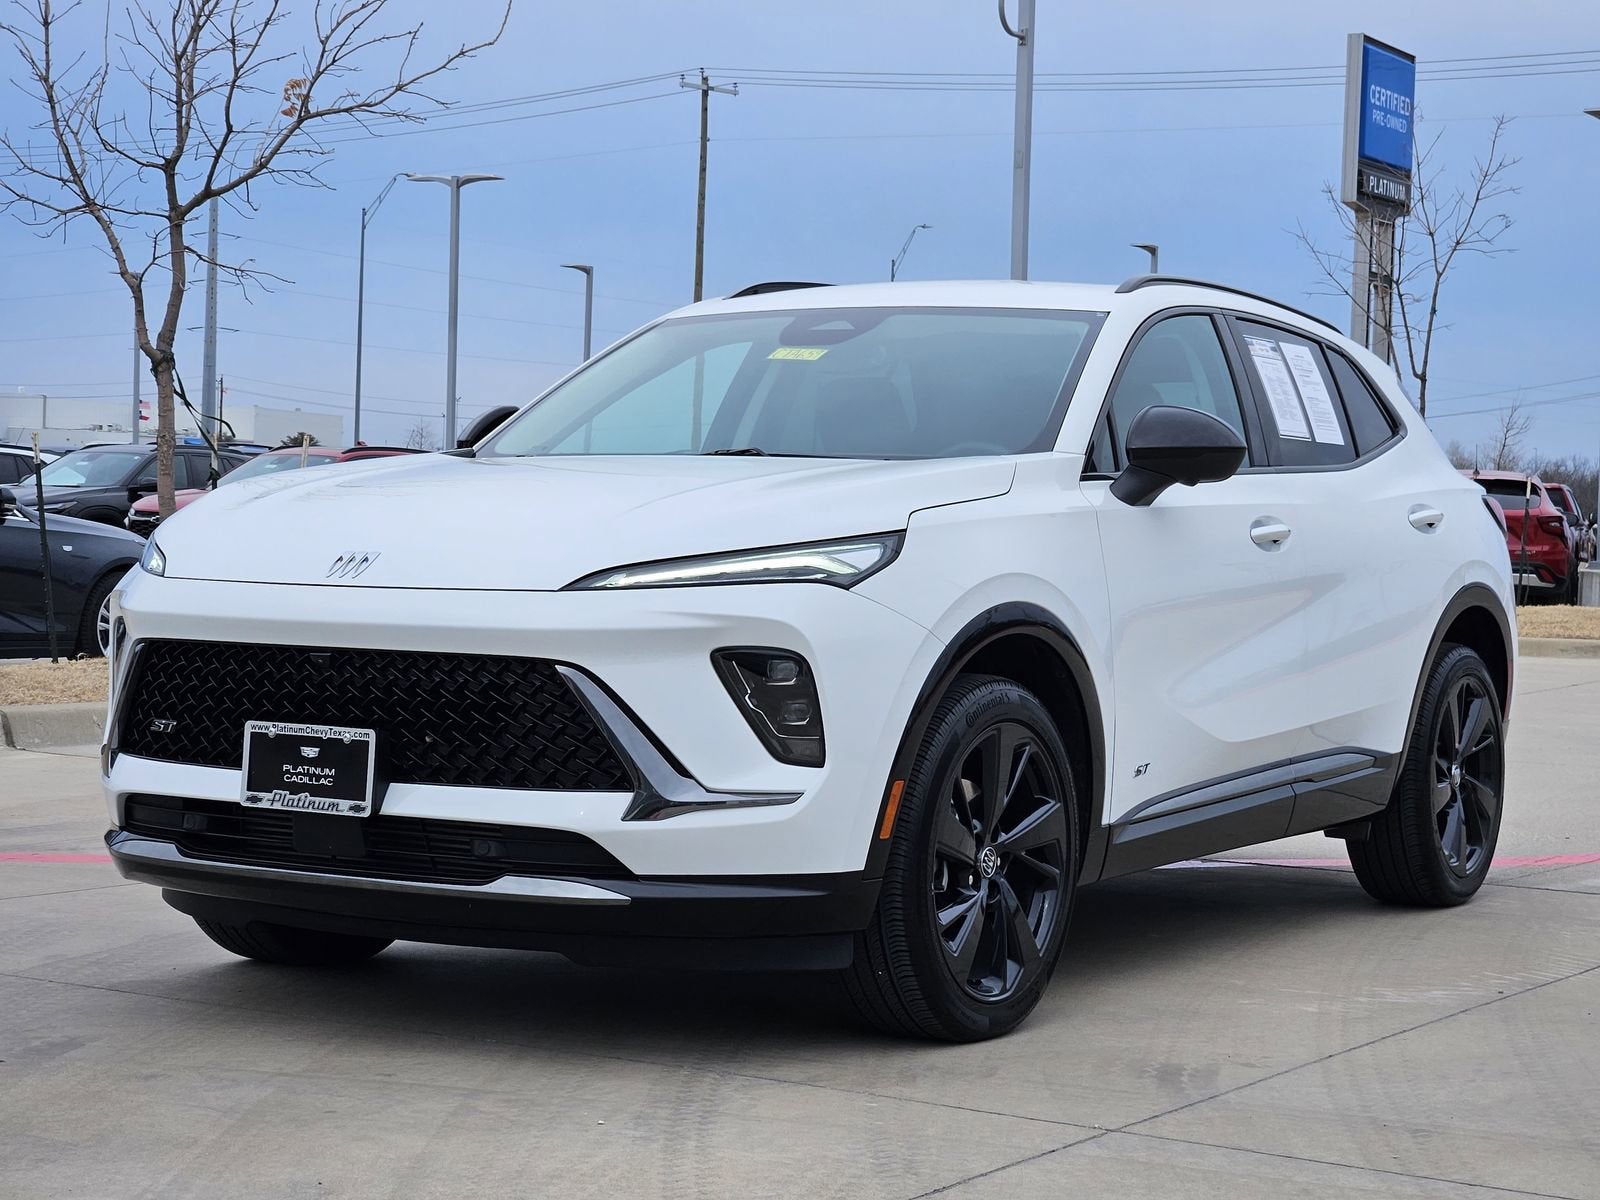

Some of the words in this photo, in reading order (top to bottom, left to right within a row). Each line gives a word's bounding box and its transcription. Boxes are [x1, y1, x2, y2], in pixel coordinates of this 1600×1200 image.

[1370, 84, 1411, 116] CERTIFIED
[1372, 108, 1407, 133] PRE-OWNED
[1369, 175, 1406, 201] PLATINUM
[282, 764, 335, 776] PLATINUM
[283, 775, 334, 786] CADILLAC
[267, 792, 345, 812] Platinum
